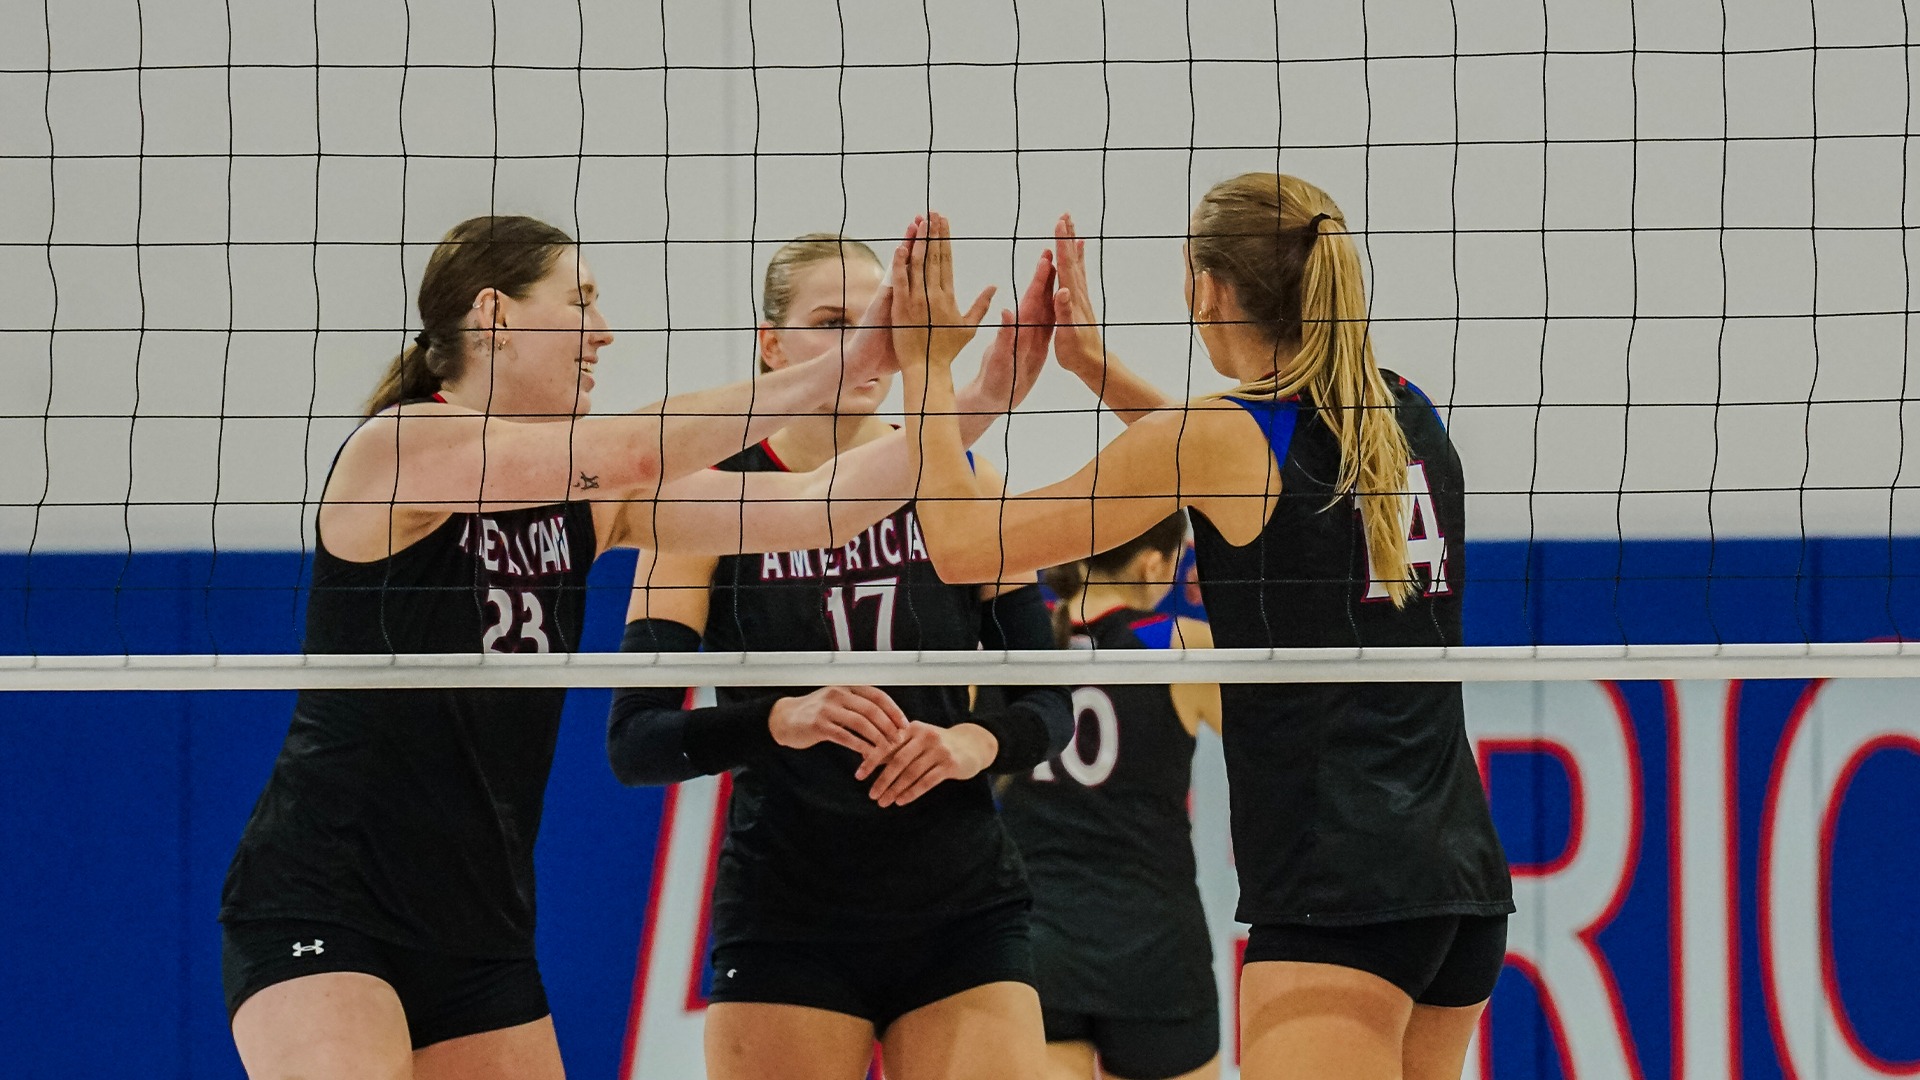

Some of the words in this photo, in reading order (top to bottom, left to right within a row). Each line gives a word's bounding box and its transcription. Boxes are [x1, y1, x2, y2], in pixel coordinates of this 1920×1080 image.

[762, 511, 930, 579] AMERICA
[483, 588, 550, 653] 23
[826, 577, 898, 650] 17
[1031, 686, 1119, 787] 0
